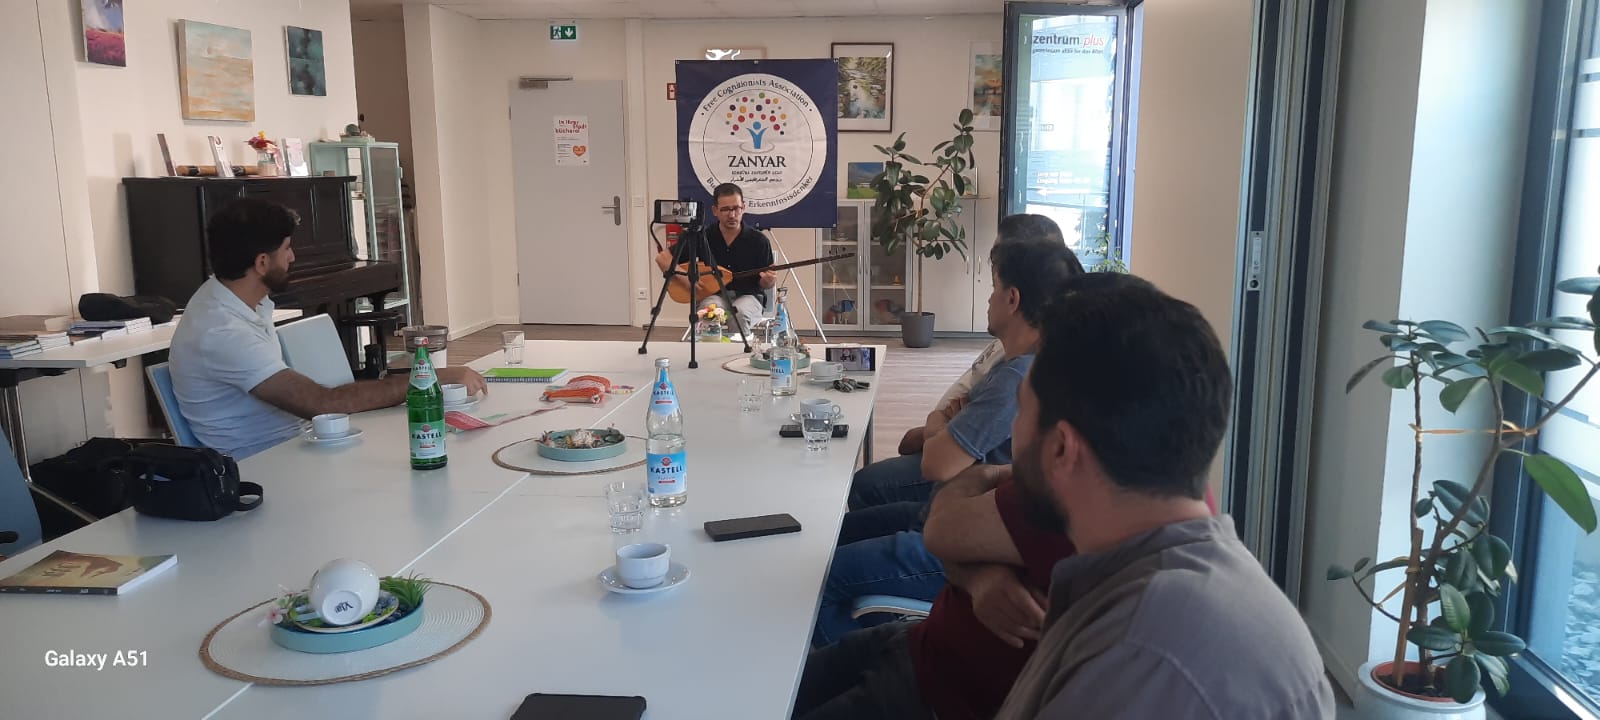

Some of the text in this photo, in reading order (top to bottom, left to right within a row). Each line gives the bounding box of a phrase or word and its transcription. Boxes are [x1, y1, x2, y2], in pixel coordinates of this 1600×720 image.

[1032, 33, 1105, 49] zentrum plus
[702, 79, 809, 112] Free Cognitionists Association
[727, 155, 787, 168] ZANYAR
[411, 431, 442, 440] KASTELL
[650, 465, 683, 474] KASTELL
